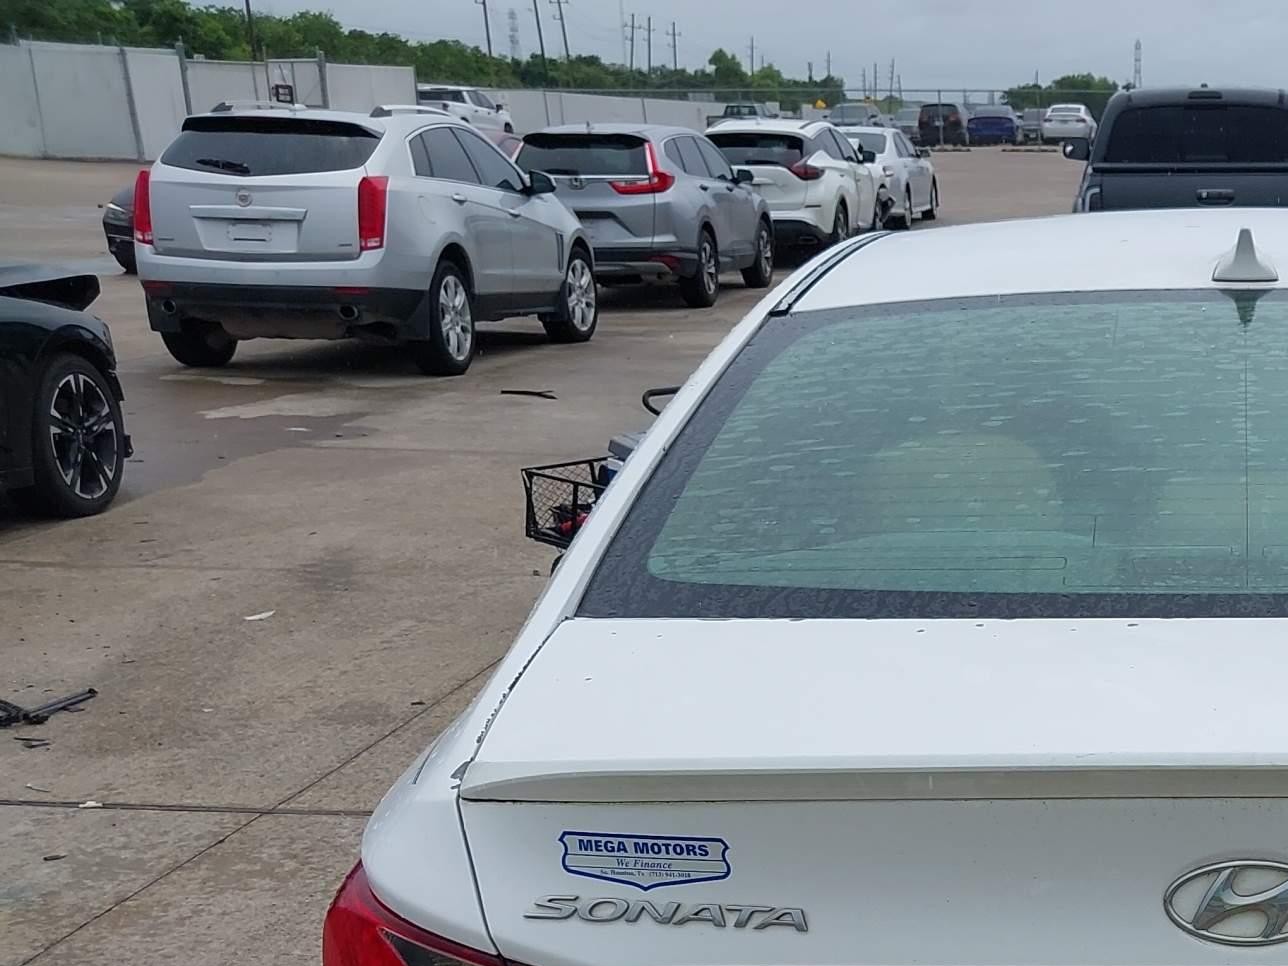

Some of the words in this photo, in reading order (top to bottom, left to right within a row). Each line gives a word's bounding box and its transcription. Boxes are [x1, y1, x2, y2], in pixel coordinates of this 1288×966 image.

[578, 839, 628, 854] MEGA
[633, 842, 710, 857] MOTORS
[616, 858, 631, 868] We
[633, 859, 673, 870] Finance
[523, 895, 809, 932] SONATA
